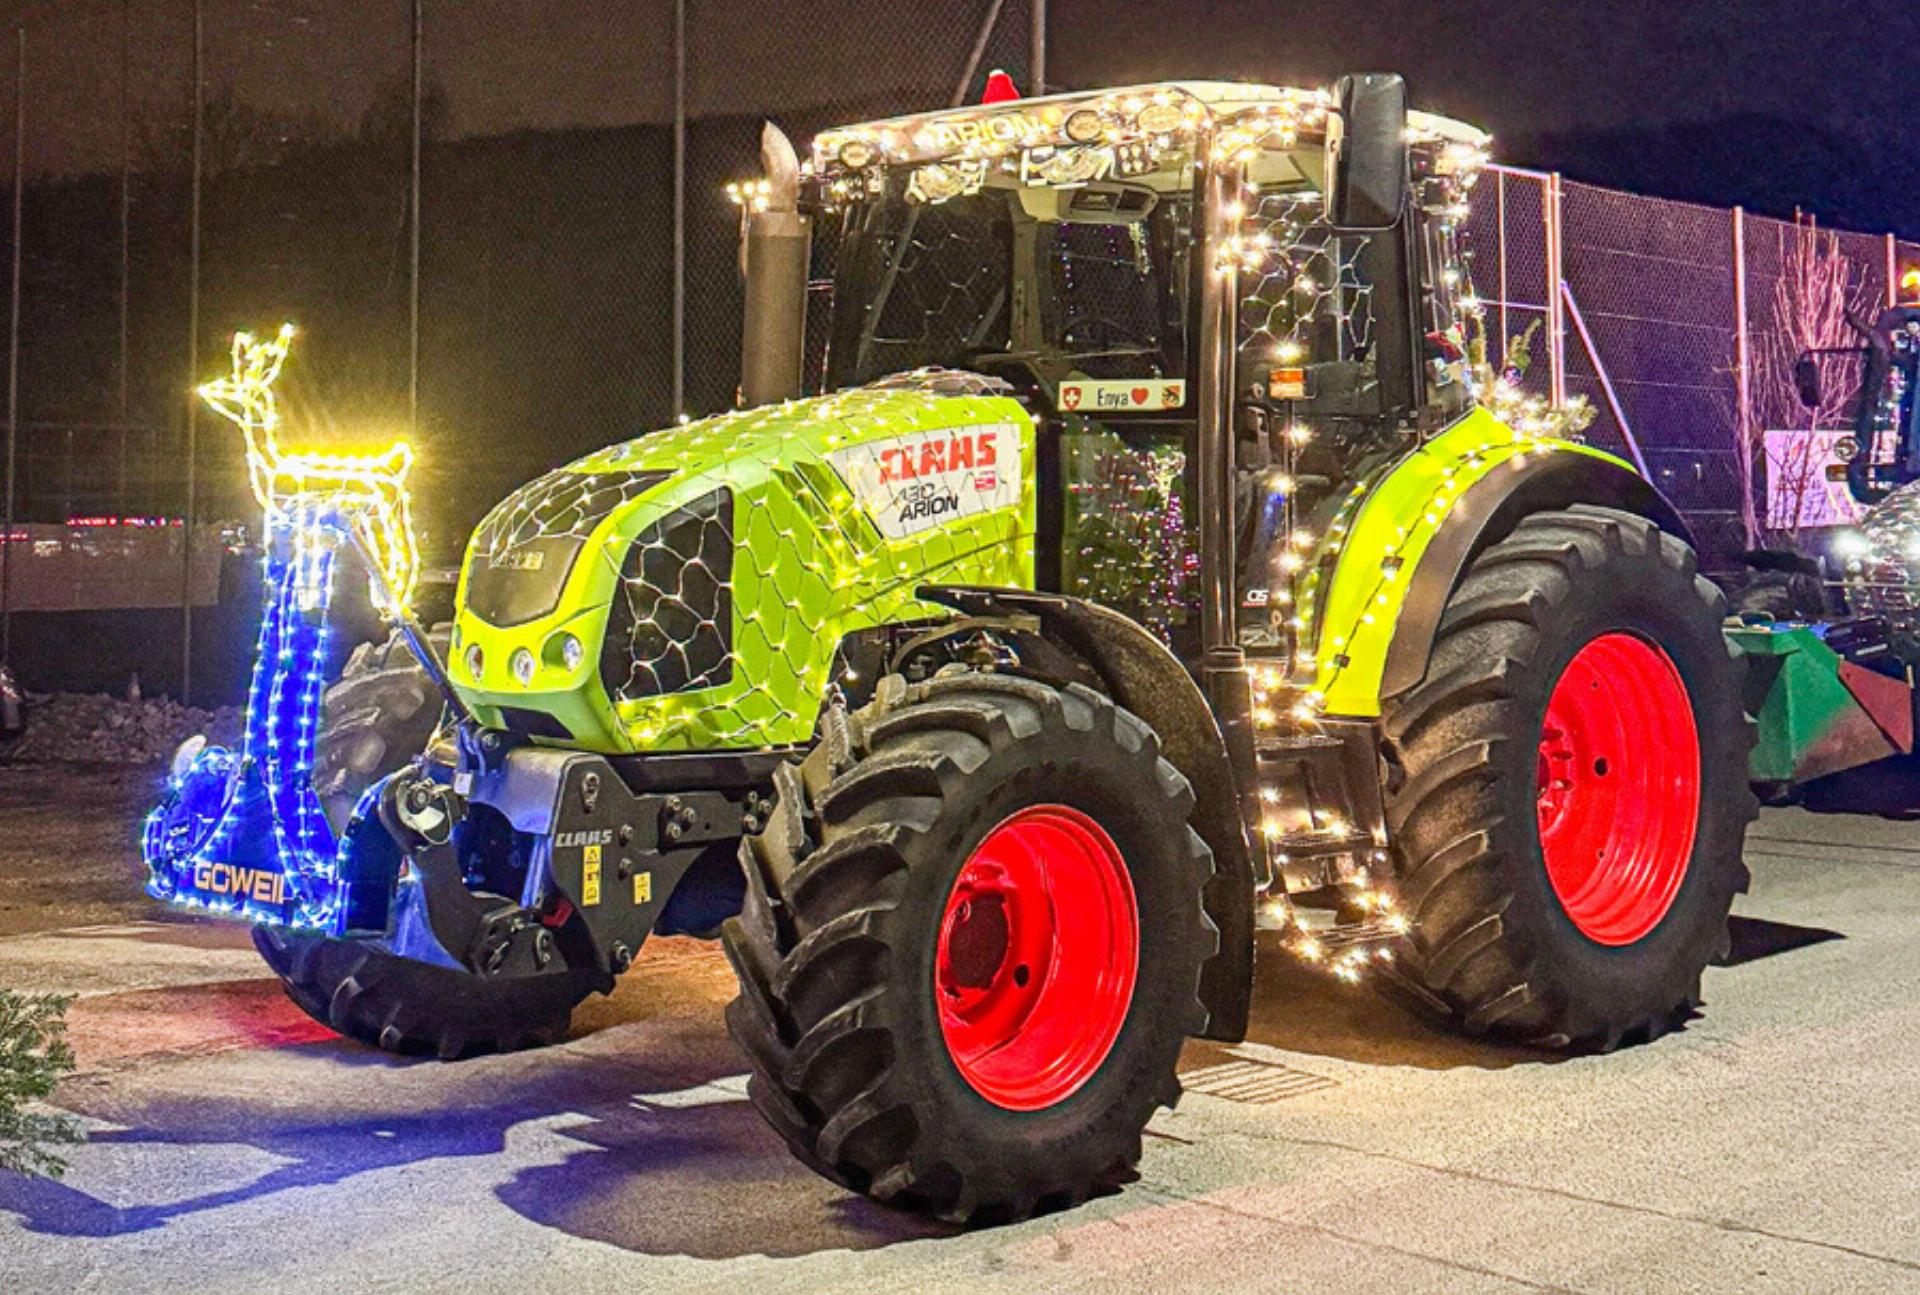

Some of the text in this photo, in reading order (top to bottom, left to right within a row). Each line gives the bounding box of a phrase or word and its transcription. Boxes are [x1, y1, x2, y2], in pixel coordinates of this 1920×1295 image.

[937, 114, 1040, 147] ARION
[1097, 387, 1129, 409] Enya
[879, 433, 997, 484] CLAAS
[899, 494, 959, 523] ARION
[555, 829, 613, 848] CLAAS
